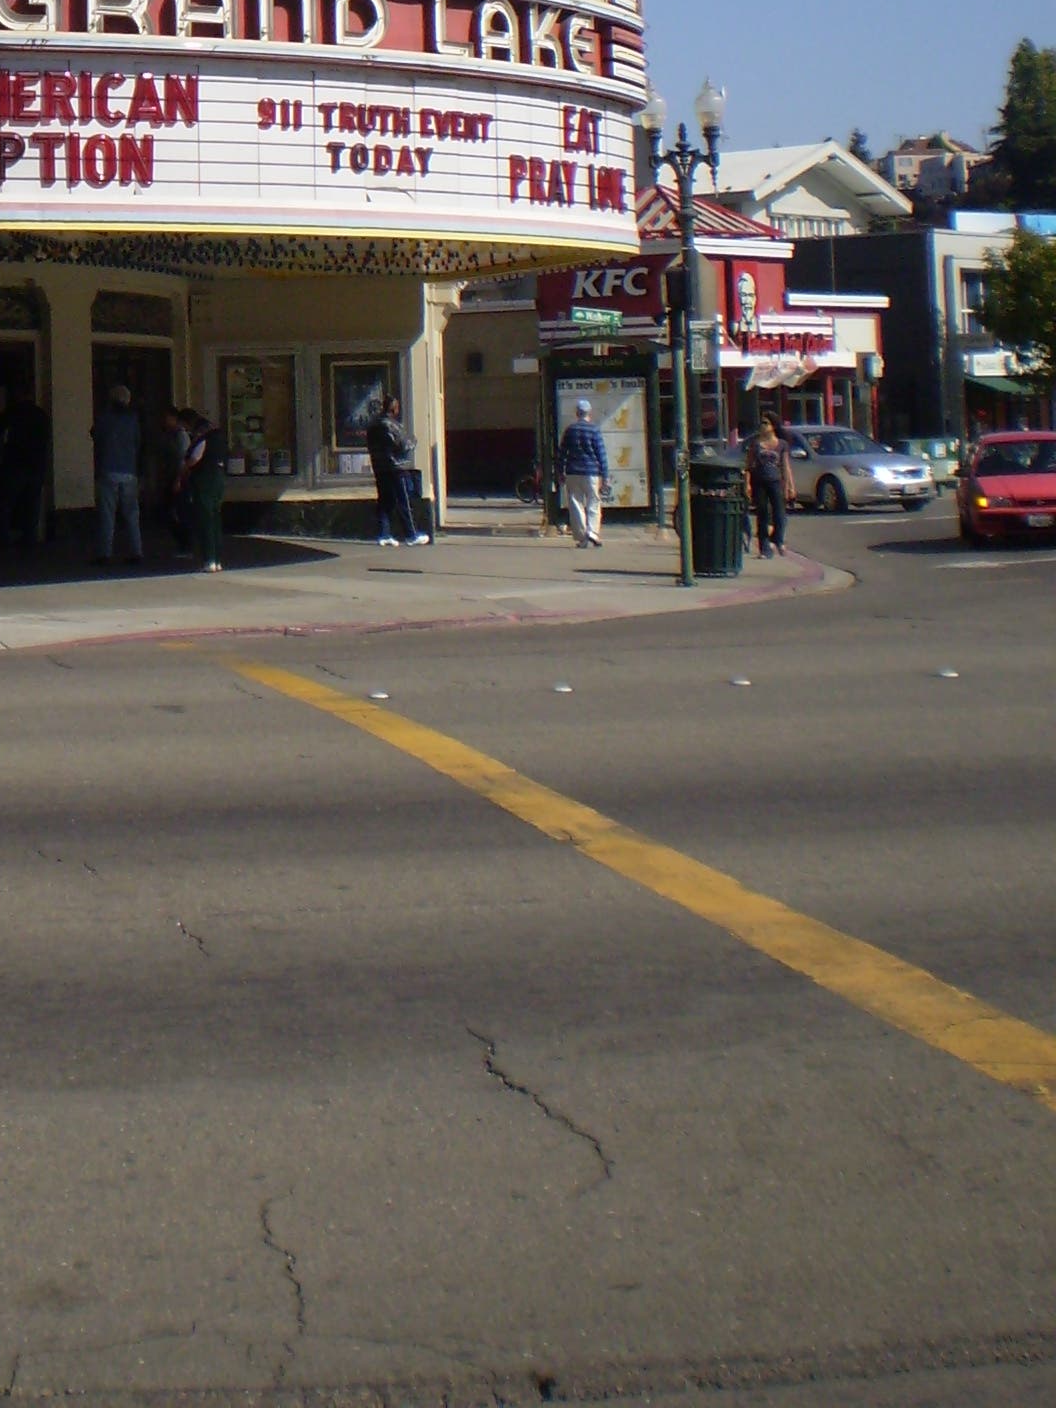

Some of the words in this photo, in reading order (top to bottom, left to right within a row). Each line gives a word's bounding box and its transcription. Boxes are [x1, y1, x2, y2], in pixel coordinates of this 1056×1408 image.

[257, 97, 303, 131] 911
[318, 102, 412, 139] TRUTH
[419, 108, 494, 144] EVENT
[562, 105, 602, 156] EAT
[326, 142, 434, 177] TODAY
[509, 154, 578, 207] PRAY
[571, 266, 649, 299] KFC
